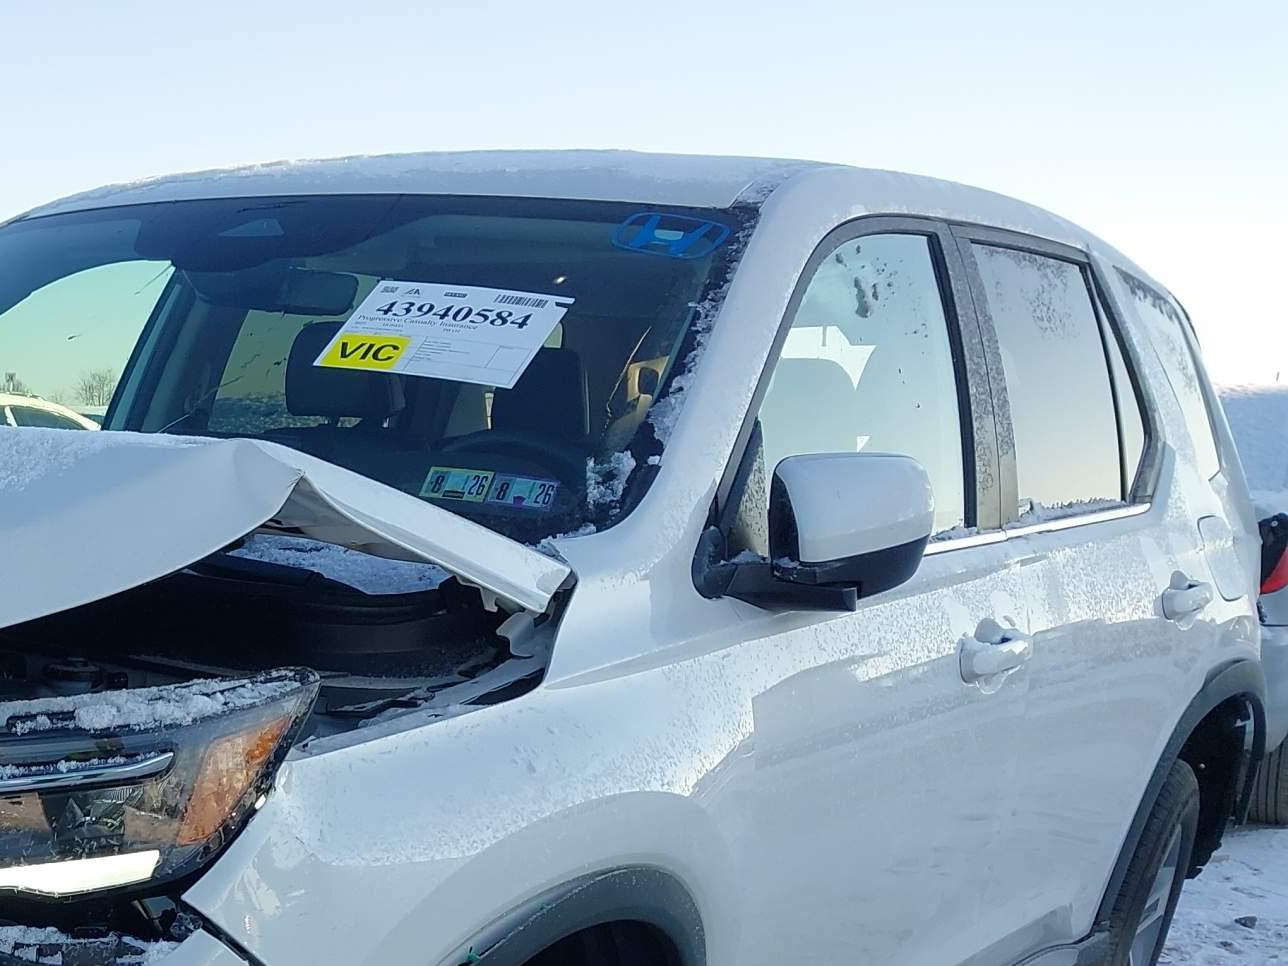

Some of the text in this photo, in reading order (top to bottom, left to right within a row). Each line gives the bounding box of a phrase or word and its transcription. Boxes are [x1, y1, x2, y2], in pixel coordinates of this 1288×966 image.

[376, 299, 534, 330] 43940584
[339, 340, 401, 362] VIC
[431, 475, 445, 493] 8
[467, 474, 489, 496] 26
[496, 481, 555, 505] 8 26
